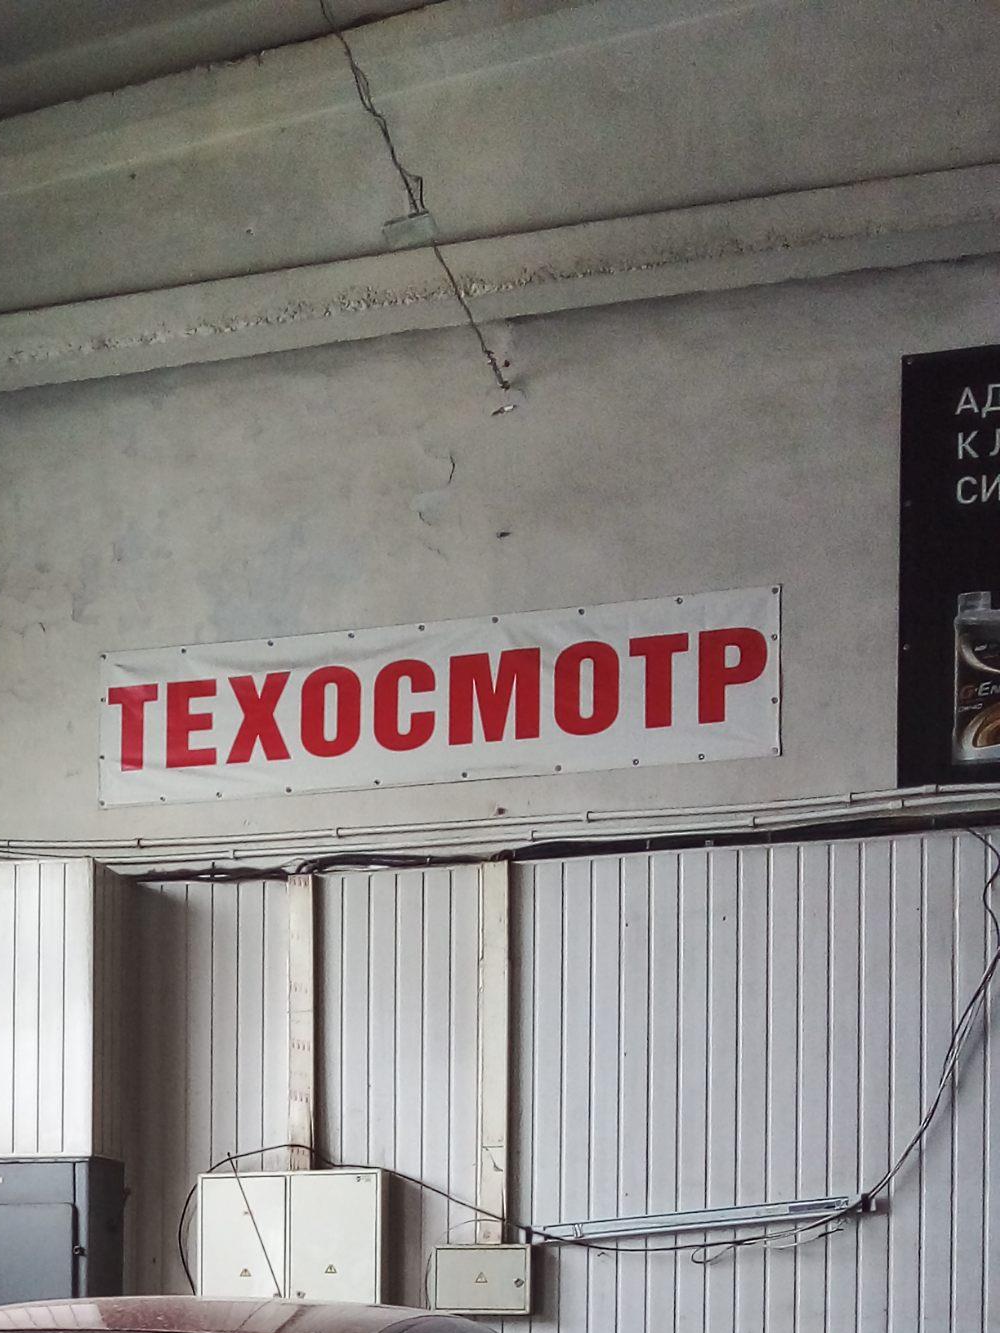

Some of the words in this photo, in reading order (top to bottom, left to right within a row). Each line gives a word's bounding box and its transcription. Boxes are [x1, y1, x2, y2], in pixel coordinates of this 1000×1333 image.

[955, 383, 1000, 418] АД
[958, 430, 979, 459] К
[956, 473, 1000, 504] СИ
[108, 627, 768, 772] ТЕХОСМОТР
